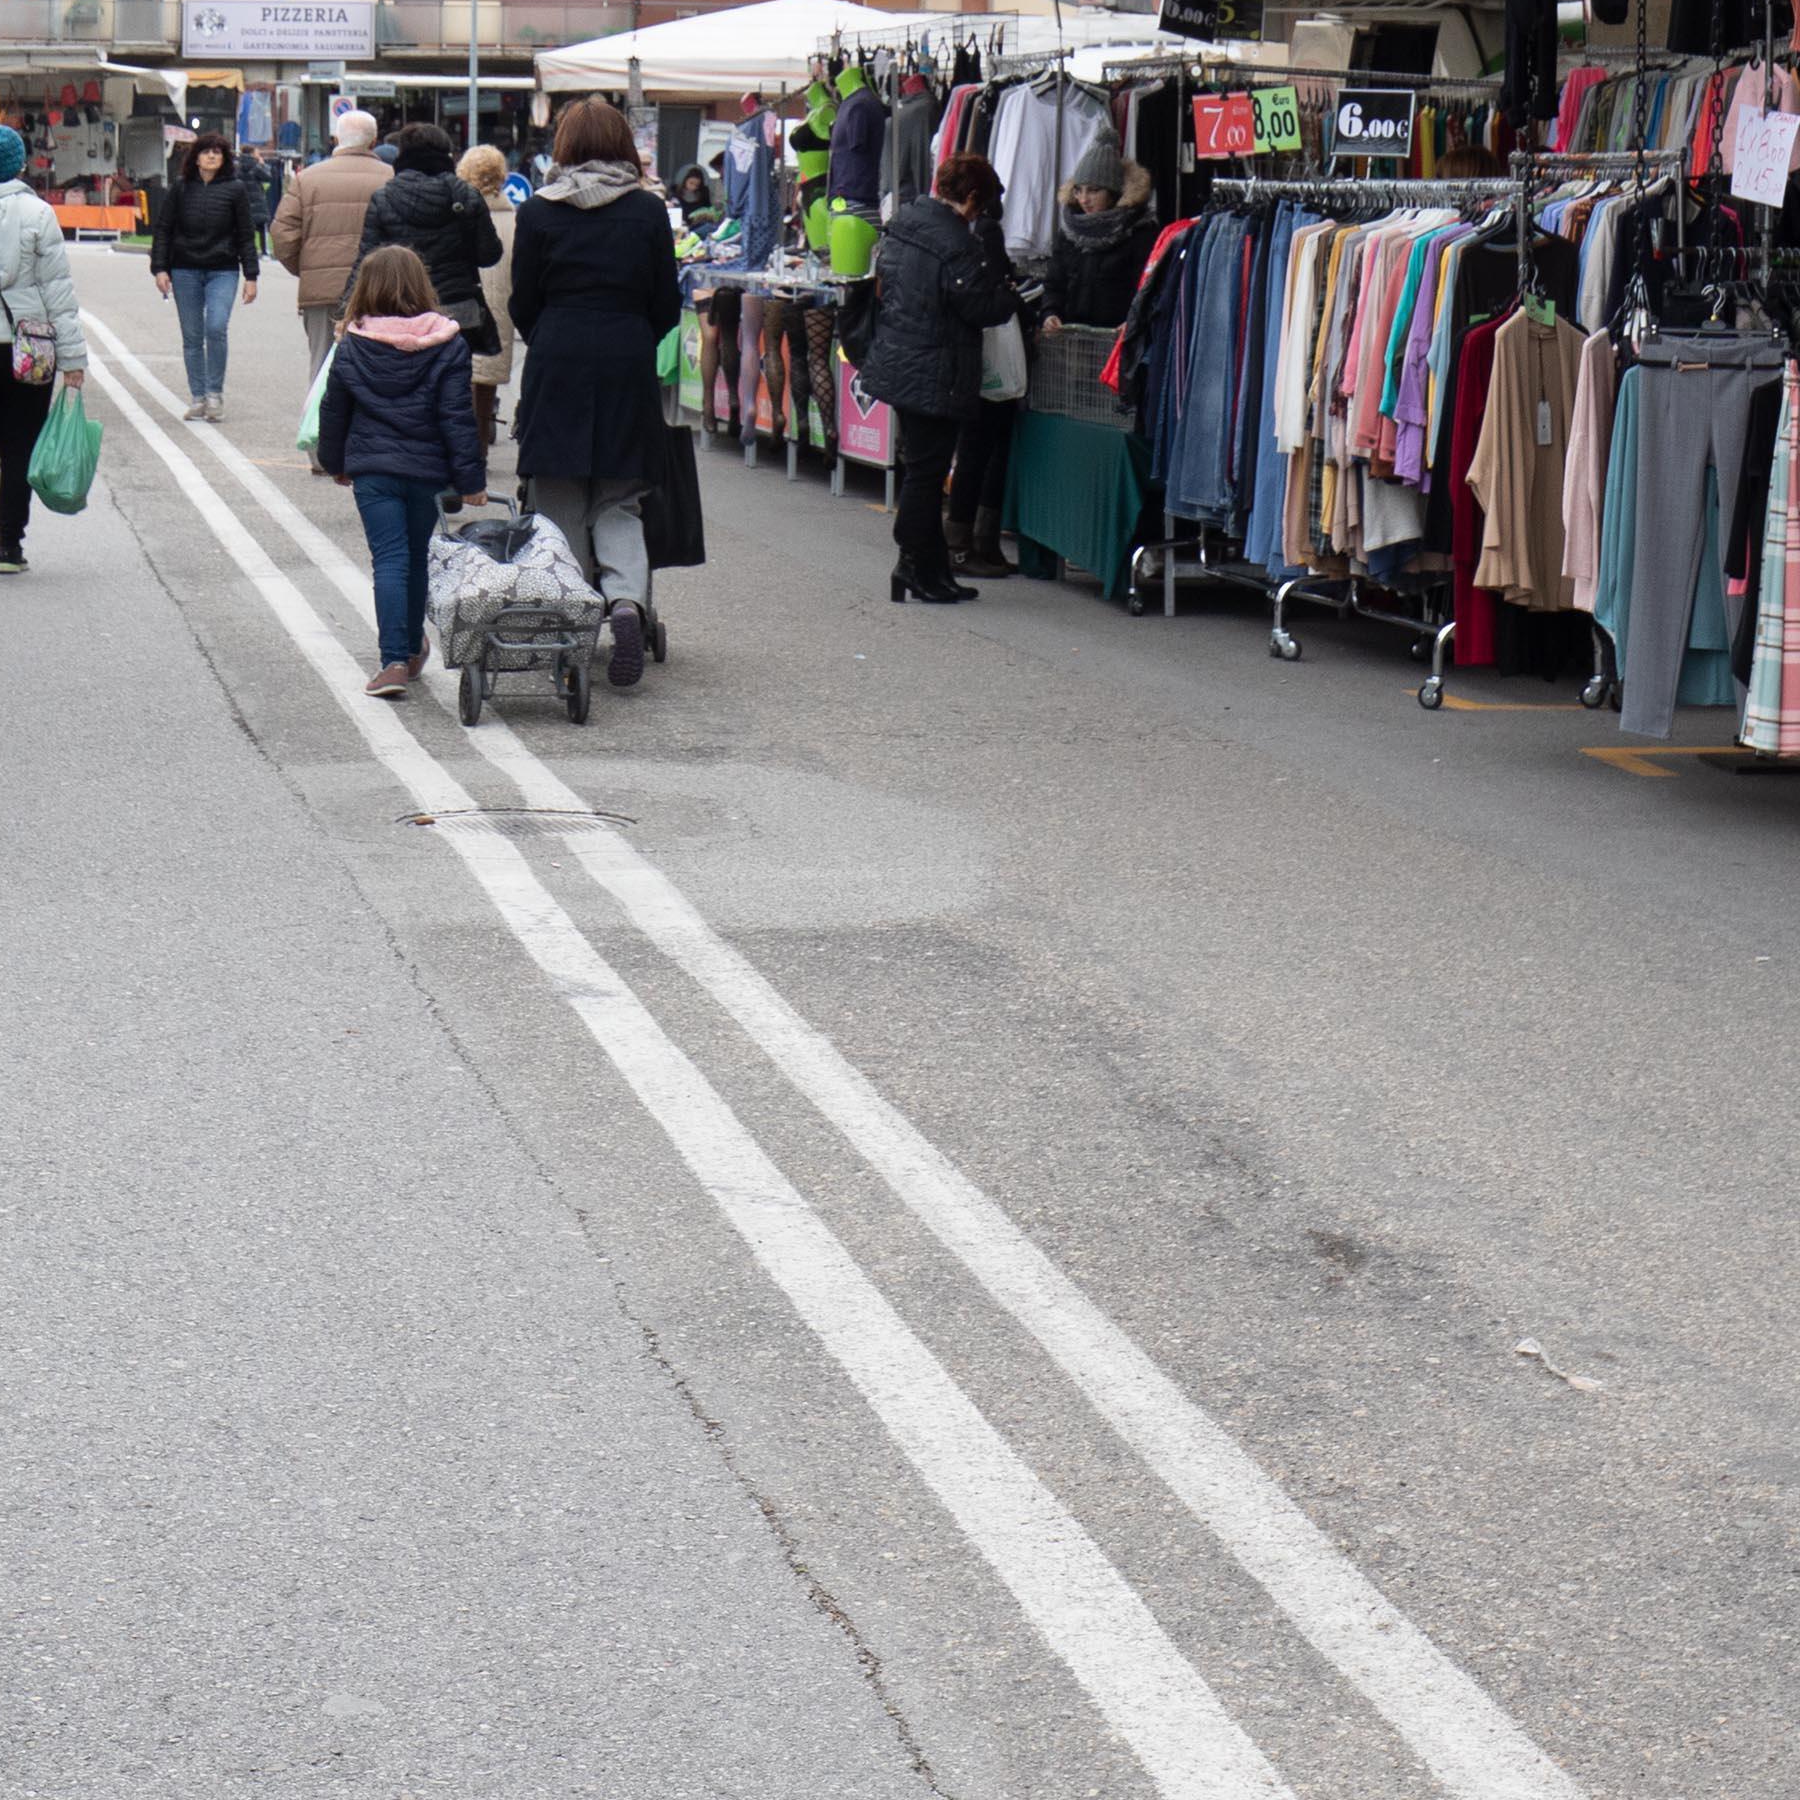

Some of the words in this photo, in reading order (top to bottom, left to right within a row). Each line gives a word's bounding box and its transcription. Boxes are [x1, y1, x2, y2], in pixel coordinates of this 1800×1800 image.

[261, 7, 348, 22] PIZZERIA
[241, 28, 268, 36] DOLCI
[276, 28, 309, 37] DELIZIE
[314, 29, 368, 37] PANETTERIA
[243, 41, 309, 50] GASTRONOMIA
[315, 42, 366, 50] SALUMERIA
